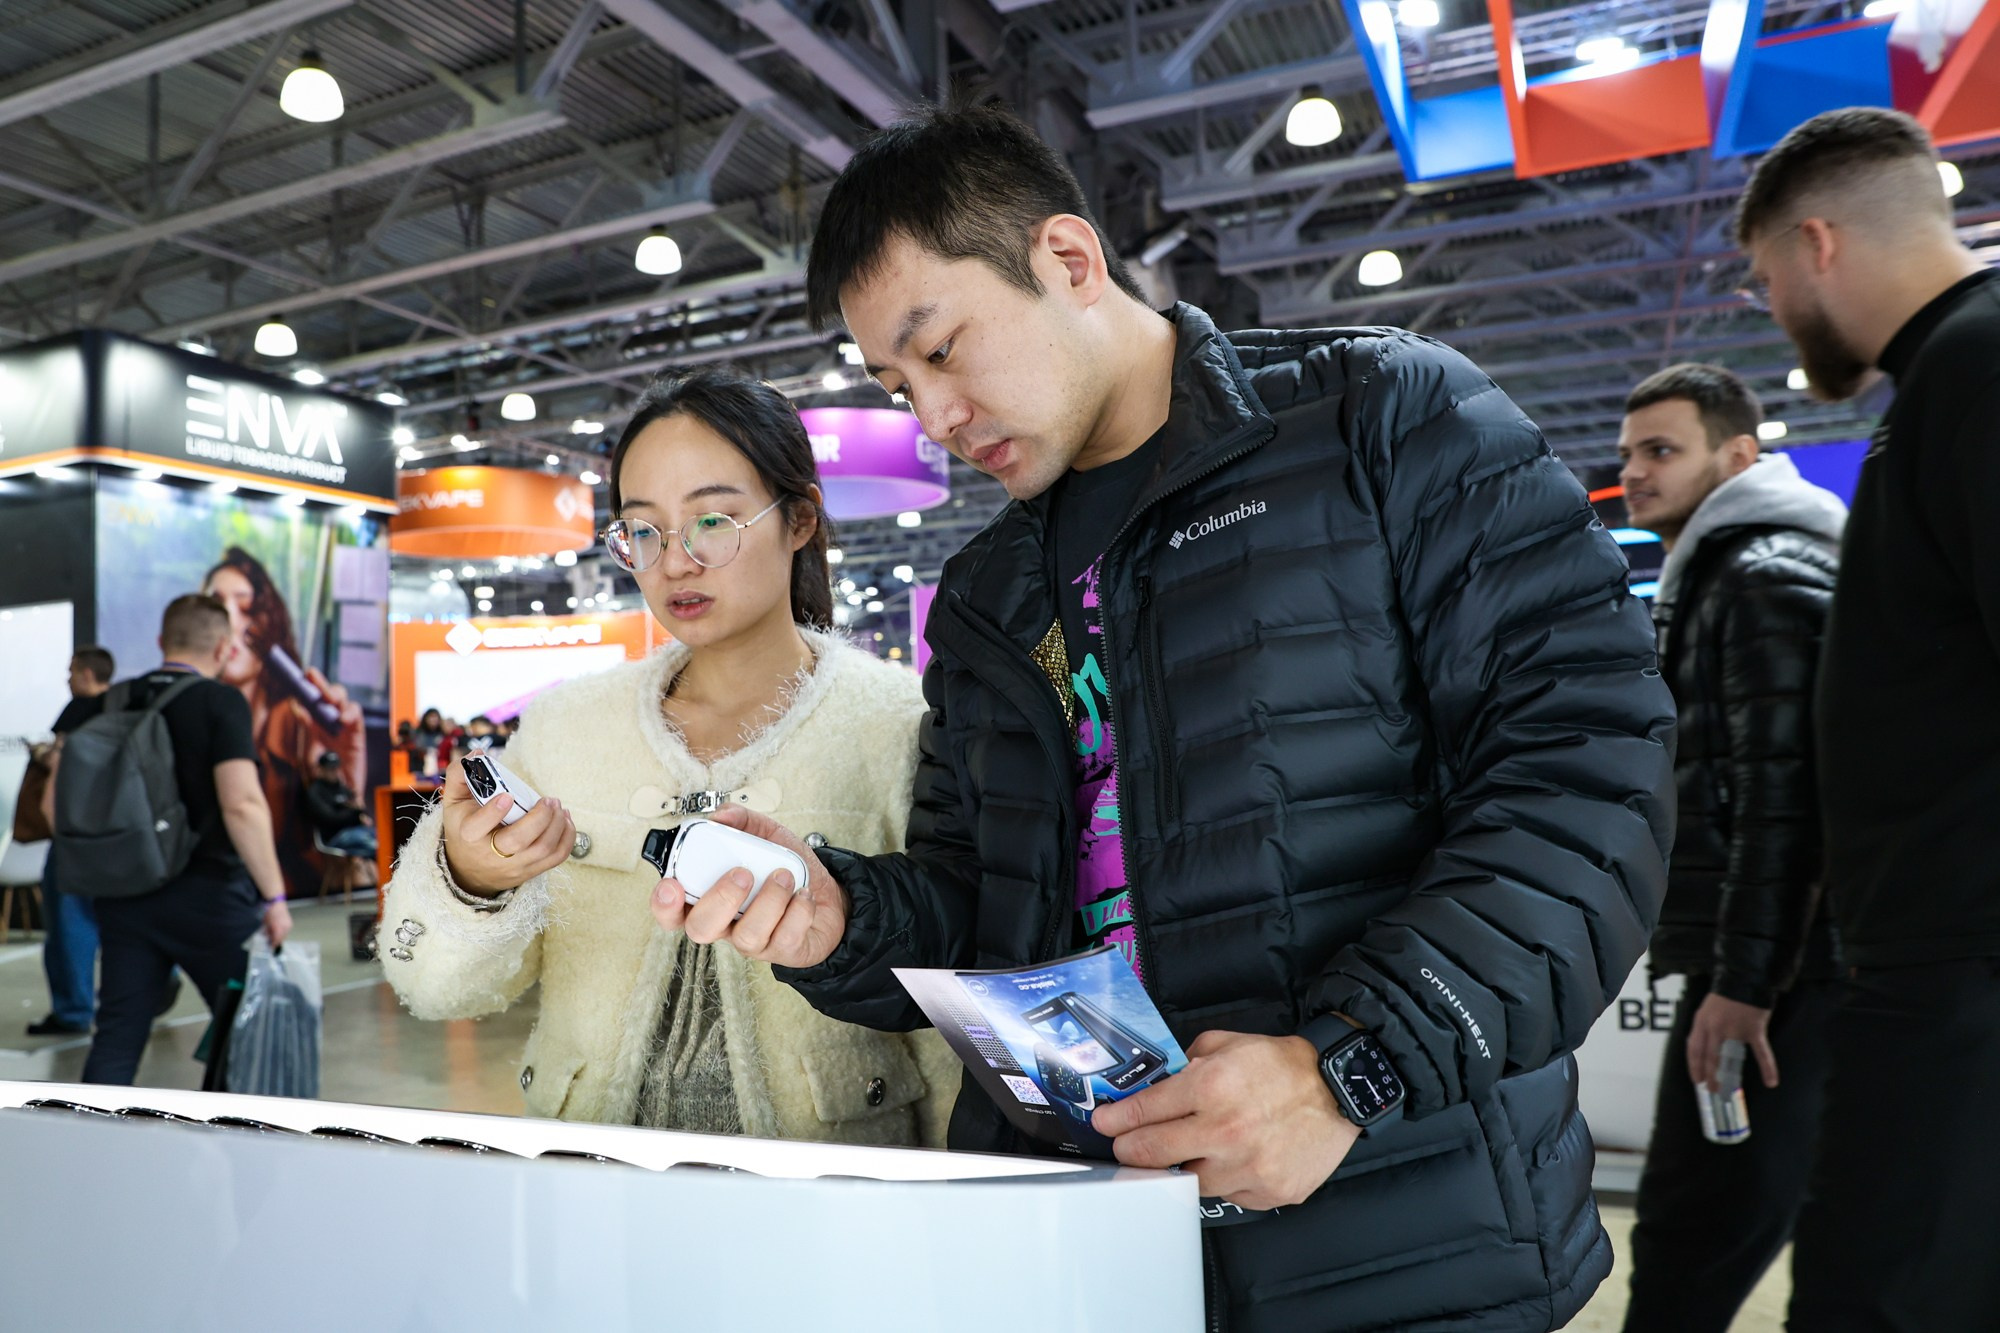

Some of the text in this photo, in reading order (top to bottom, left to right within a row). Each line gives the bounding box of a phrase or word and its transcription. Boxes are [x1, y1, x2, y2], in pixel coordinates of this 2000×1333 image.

[400, 488, 484, 512] EKVAPE
[1185, 500, 1267, 541] Columbia
[1420, 968, 1491, 1059] OMNI-HEAT
[1619, 999, 1675, 1030] BE
